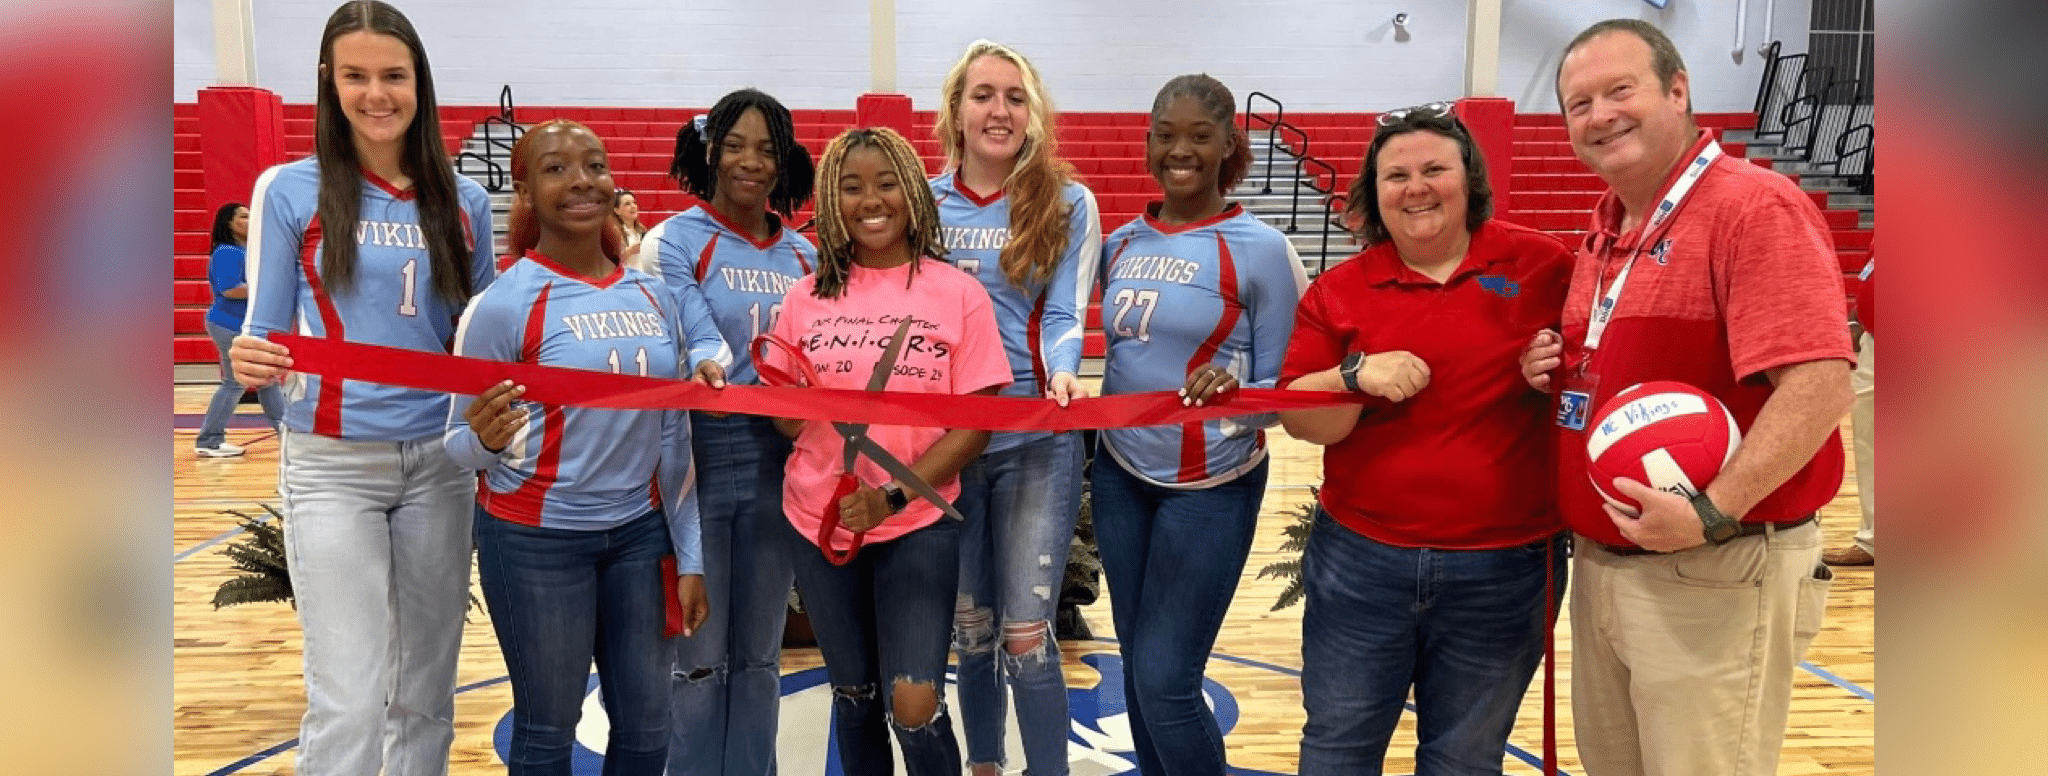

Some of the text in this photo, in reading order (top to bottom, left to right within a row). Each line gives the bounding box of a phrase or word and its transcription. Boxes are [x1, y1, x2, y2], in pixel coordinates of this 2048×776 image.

[398, 258, 418, 317] 1
[561, 310, 664, 341] VIKINGS
[834, 315, 874, 328] FINAL
[1112, 288, 1161, 343] 27
[835, 359, 853, 374] 20
